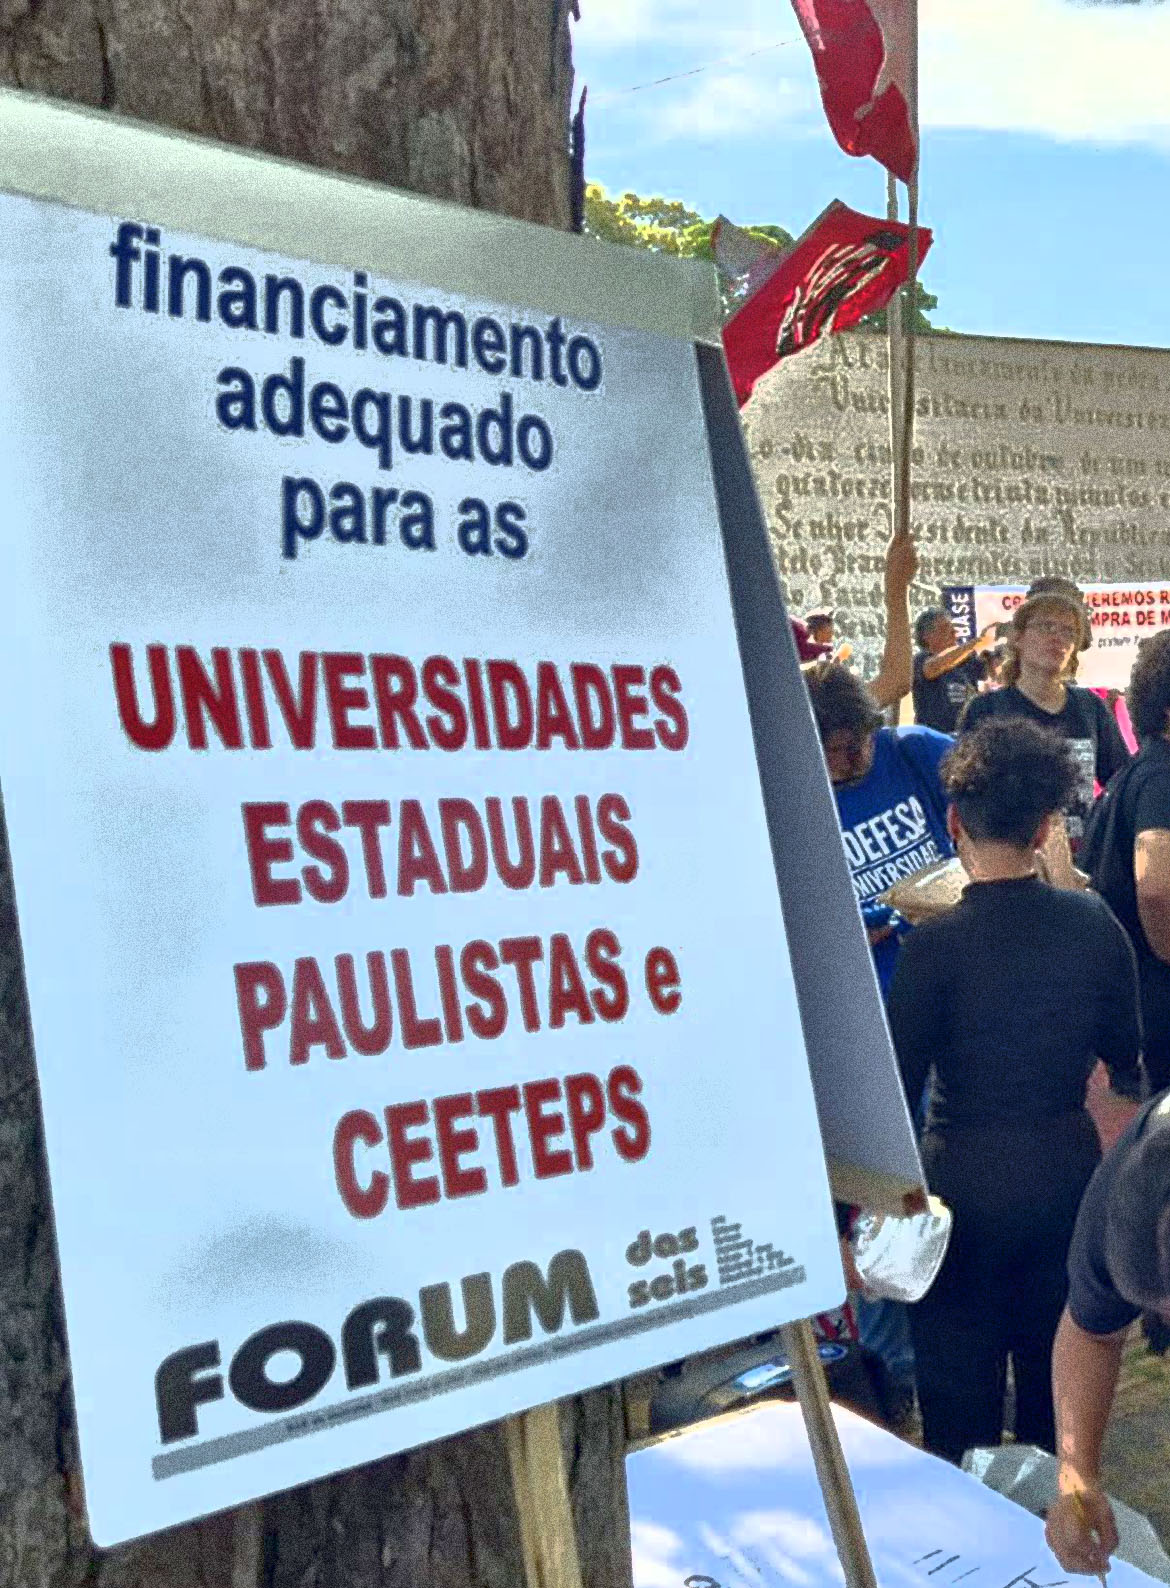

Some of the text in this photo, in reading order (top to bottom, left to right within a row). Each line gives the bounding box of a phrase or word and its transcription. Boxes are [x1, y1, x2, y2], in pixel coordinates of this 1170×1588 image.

[110, 222, 603, 391] financiamento
[216, 357, 553, 472] adequado
[282, 476, 528, 560] para as
[1135, 609, 1156, 626] DE
[111, 643, 688, 751] UNIVERSIDADES
[244, 795, 638, 904] ESTADUAIS
[236, 930, 681, 1068] PAULISTAS e
[336, 1066, 651, 1218] CEETEPS
[627, 1257, 709, 1310] seis
[152, 1250, 602, 1445] FORUM
